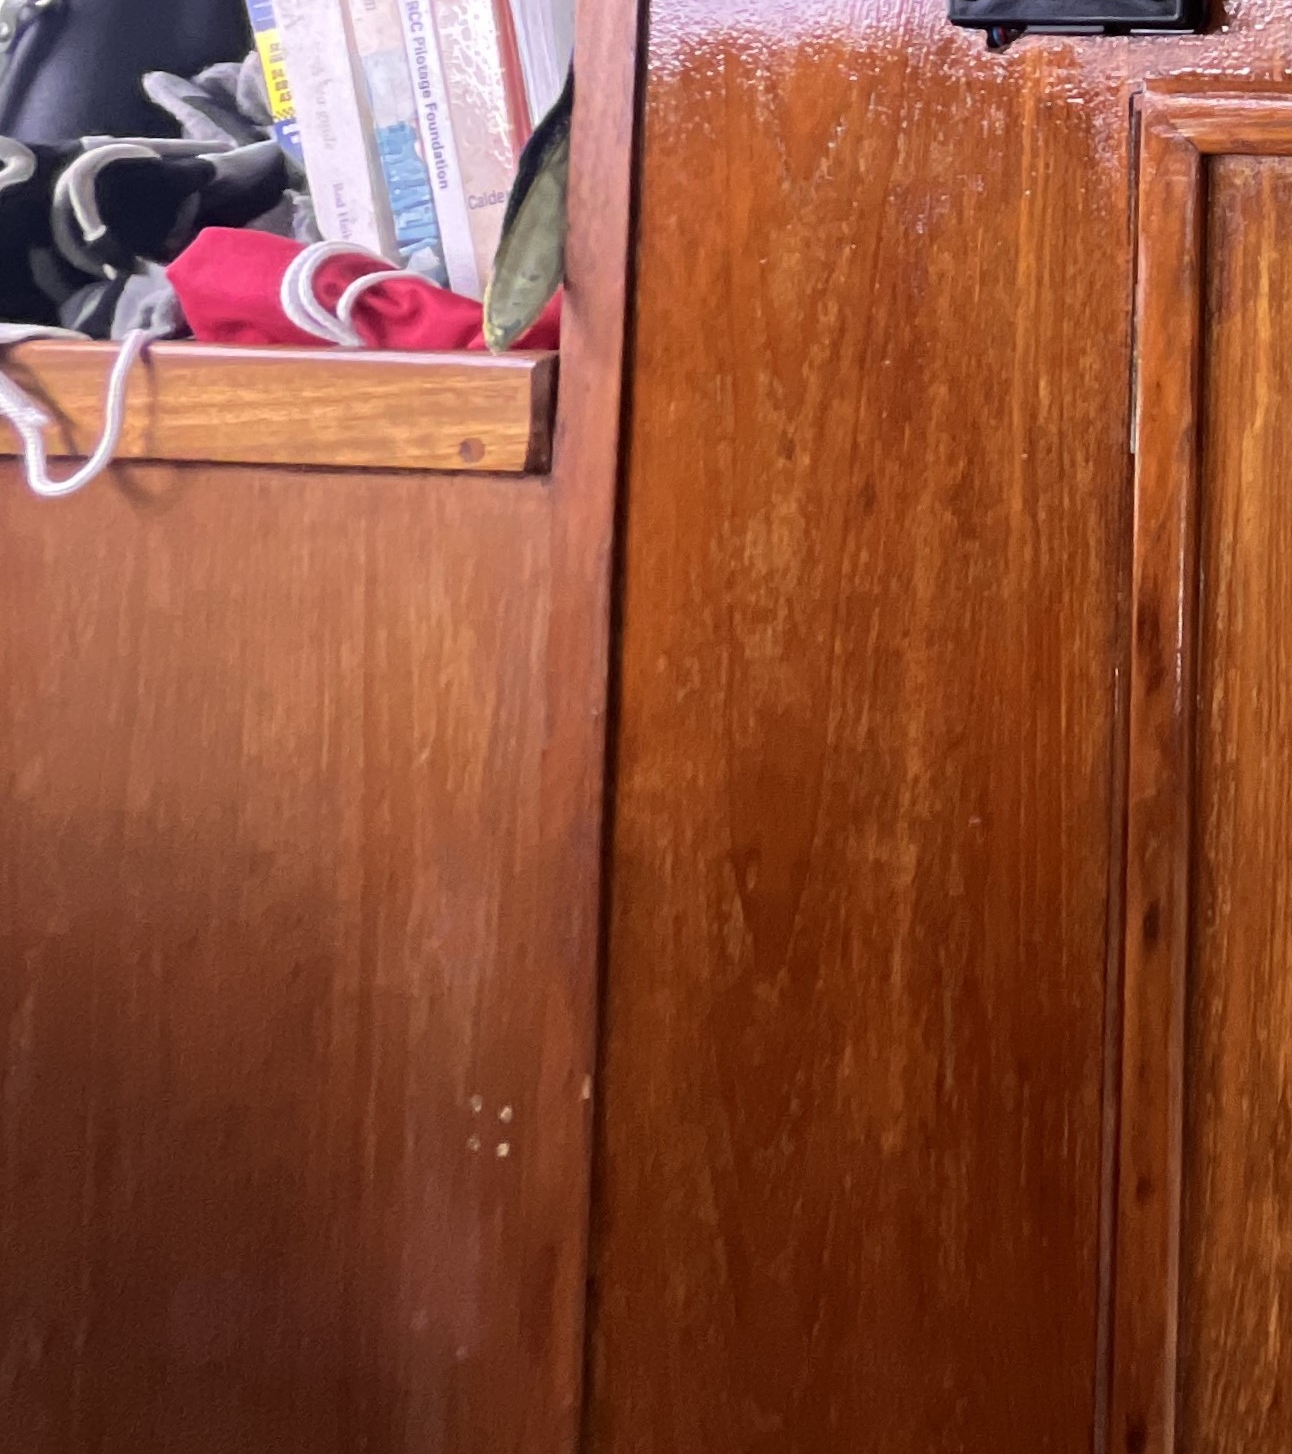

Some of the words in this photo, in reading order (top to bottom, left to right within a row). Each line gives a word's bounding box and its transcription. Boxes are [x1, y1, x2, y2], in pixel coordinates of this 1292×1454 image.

[406, 0, 423, 33] RCC
[412, 33, 431, 100] Pilotage
[425, 103, 448, 191] Foundation
[468, 189, 508, 212] Calde
